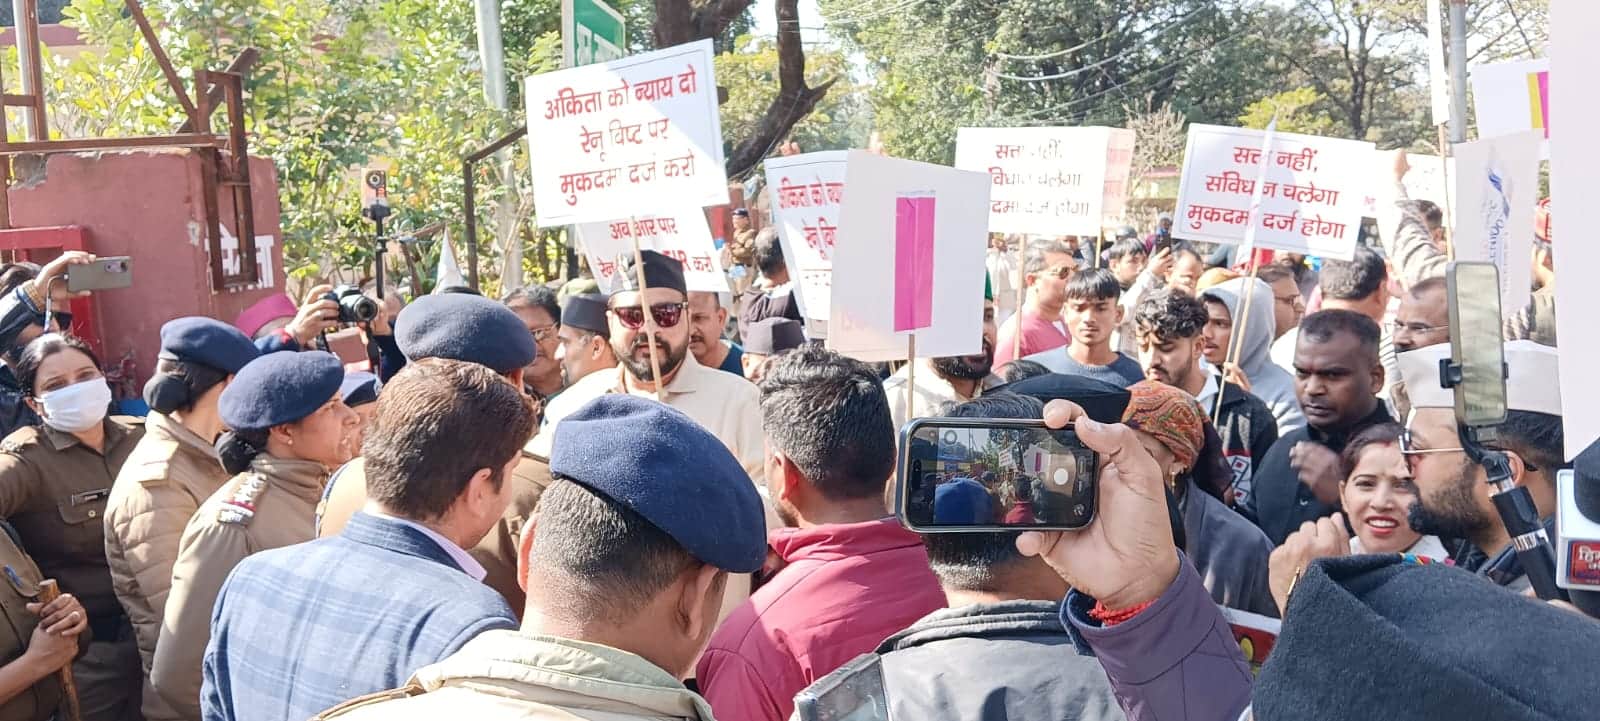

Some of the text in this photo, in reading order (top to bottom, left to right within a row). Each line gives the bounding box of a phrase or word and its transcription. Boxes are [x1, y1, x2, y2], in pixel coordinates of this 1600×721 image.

[607, 78, 629, 108] को
[634, 75, 674, 102] न्याय
[677, 63, 697, 94] दो
[579, 125, 606, 162] रेनू
[648, 118, 670, 140] पर
[663, 149, 696, 178] करो
[1282, 182, 1340, 207] चलेगा
[1262, 210, 1298, 232] दर्ज
[1300, 214, 1346, 240] होगा
